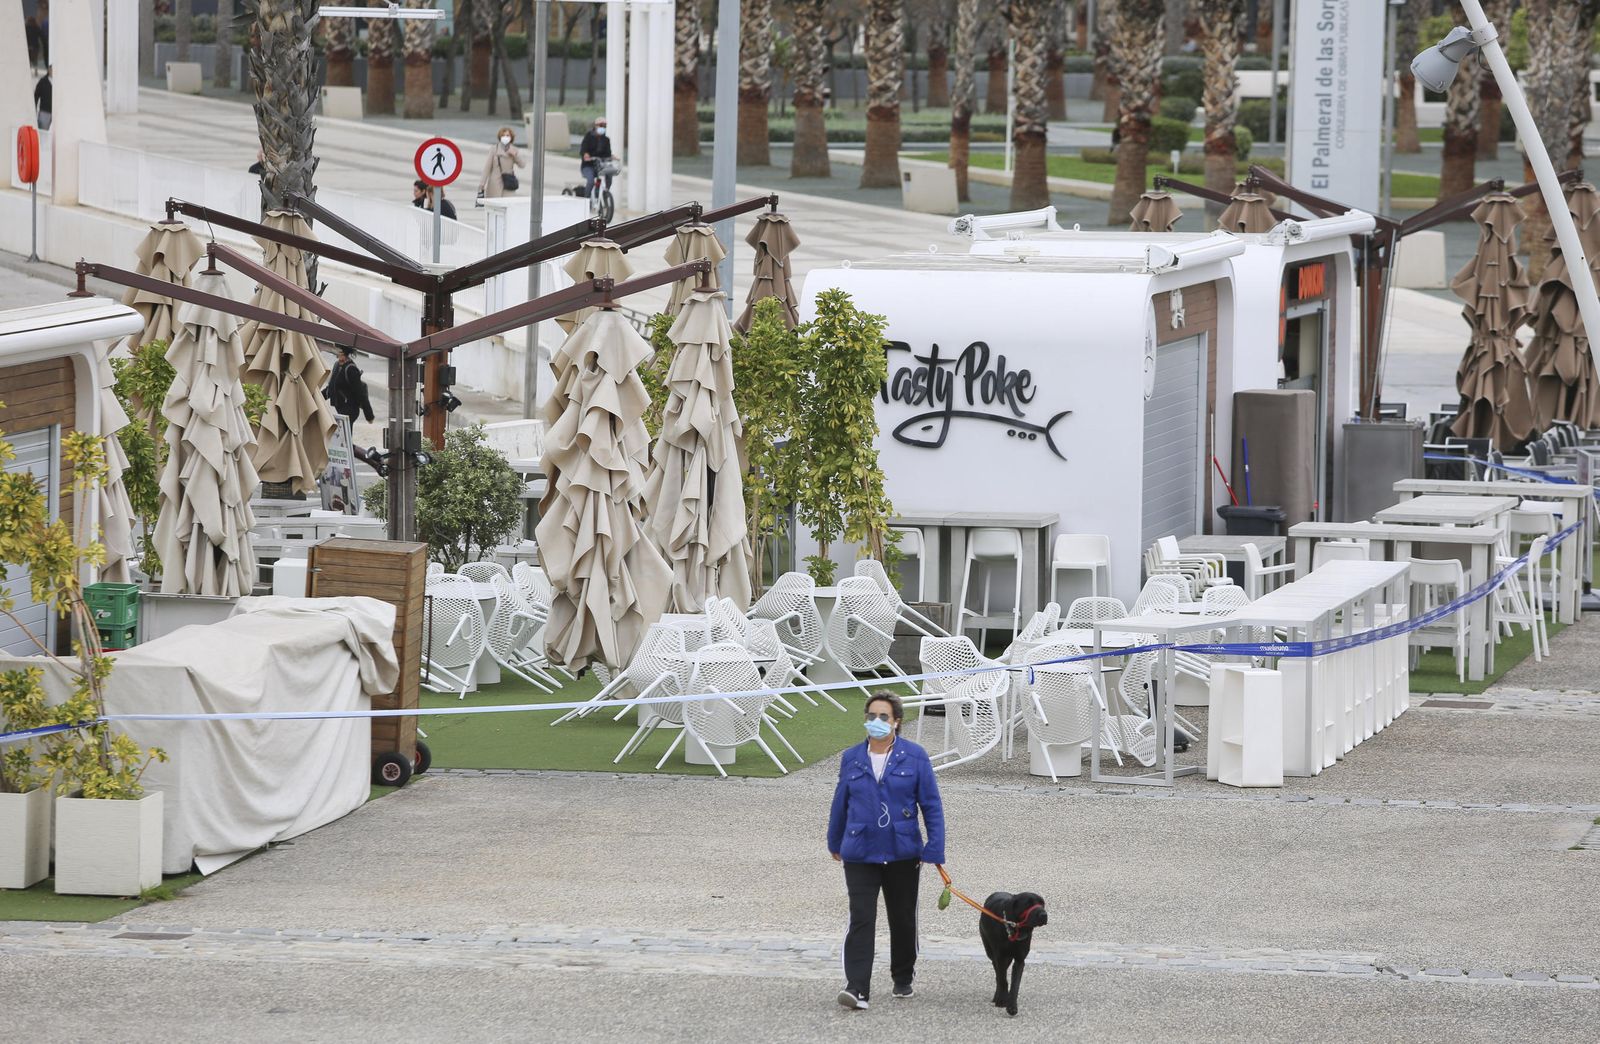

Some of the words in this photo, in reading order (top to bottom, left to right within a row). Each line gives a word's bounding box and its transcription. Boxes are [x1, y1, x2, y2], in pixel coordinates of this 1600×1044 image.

[1316, 38, 1334, 61] las
[1337, 45, 1348, 77] OBRAS
[1315, 67, 1333, 87] de
[1337, 79, 1347, 92] DE
[1312, 93, 1332, 168] Palmeral
[1311, 174, 1329, 190] El
[880, 341, 957, 415] Tasty
[955, 341, 1037, 417] Poke
